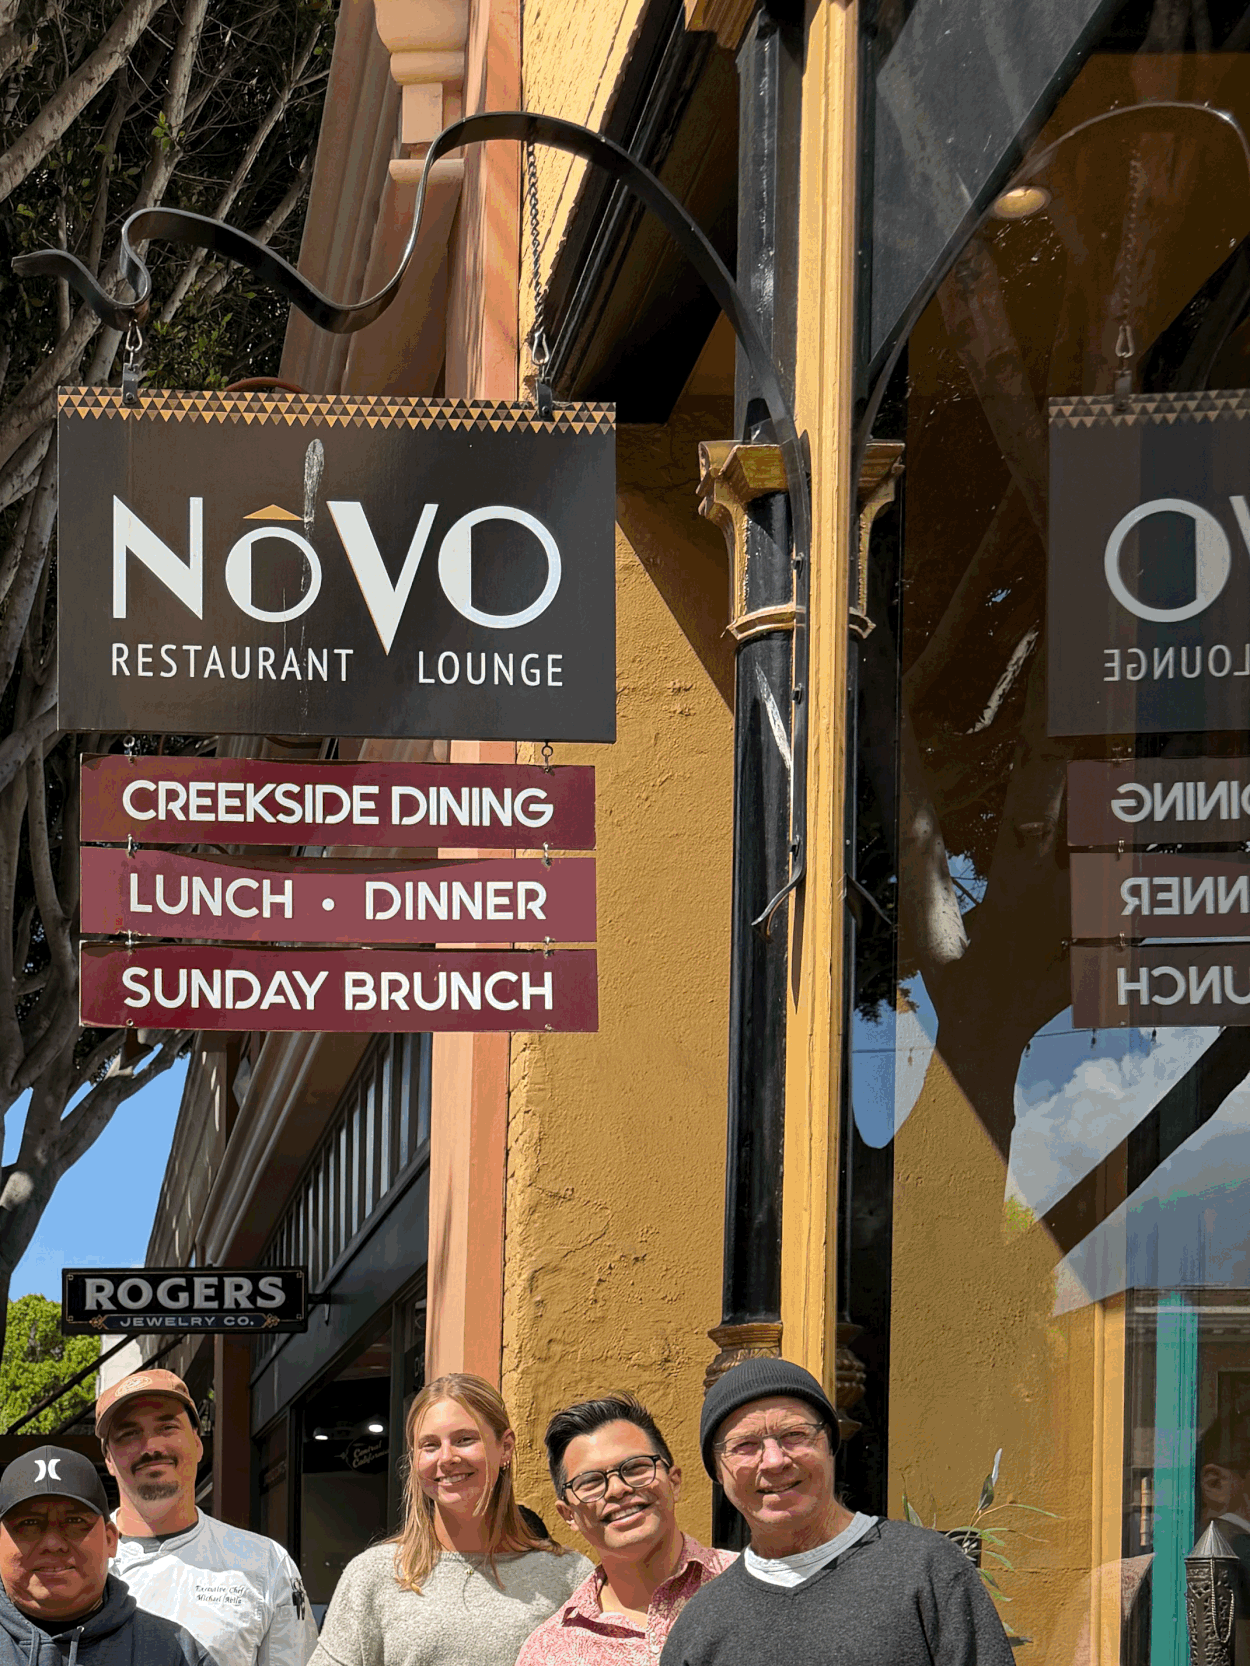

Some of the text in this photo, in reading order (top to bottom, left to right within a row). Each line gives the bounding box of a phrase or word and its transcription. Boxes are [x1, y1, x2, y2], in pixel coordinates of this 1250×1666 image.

[111, 642, 564, 687] RESTAURANT LOUNGE
[122, 779, 555, 829] CREEKSIDE DINING
[129, 872, 547, 920] LUNCH DINNER
[122, 966, 554, 1012] SUNDAY BRUNCH
[84, 1276, 286, 1310] ROGERS
[120, 1316, 254, 1327] JEWELRY CO.
